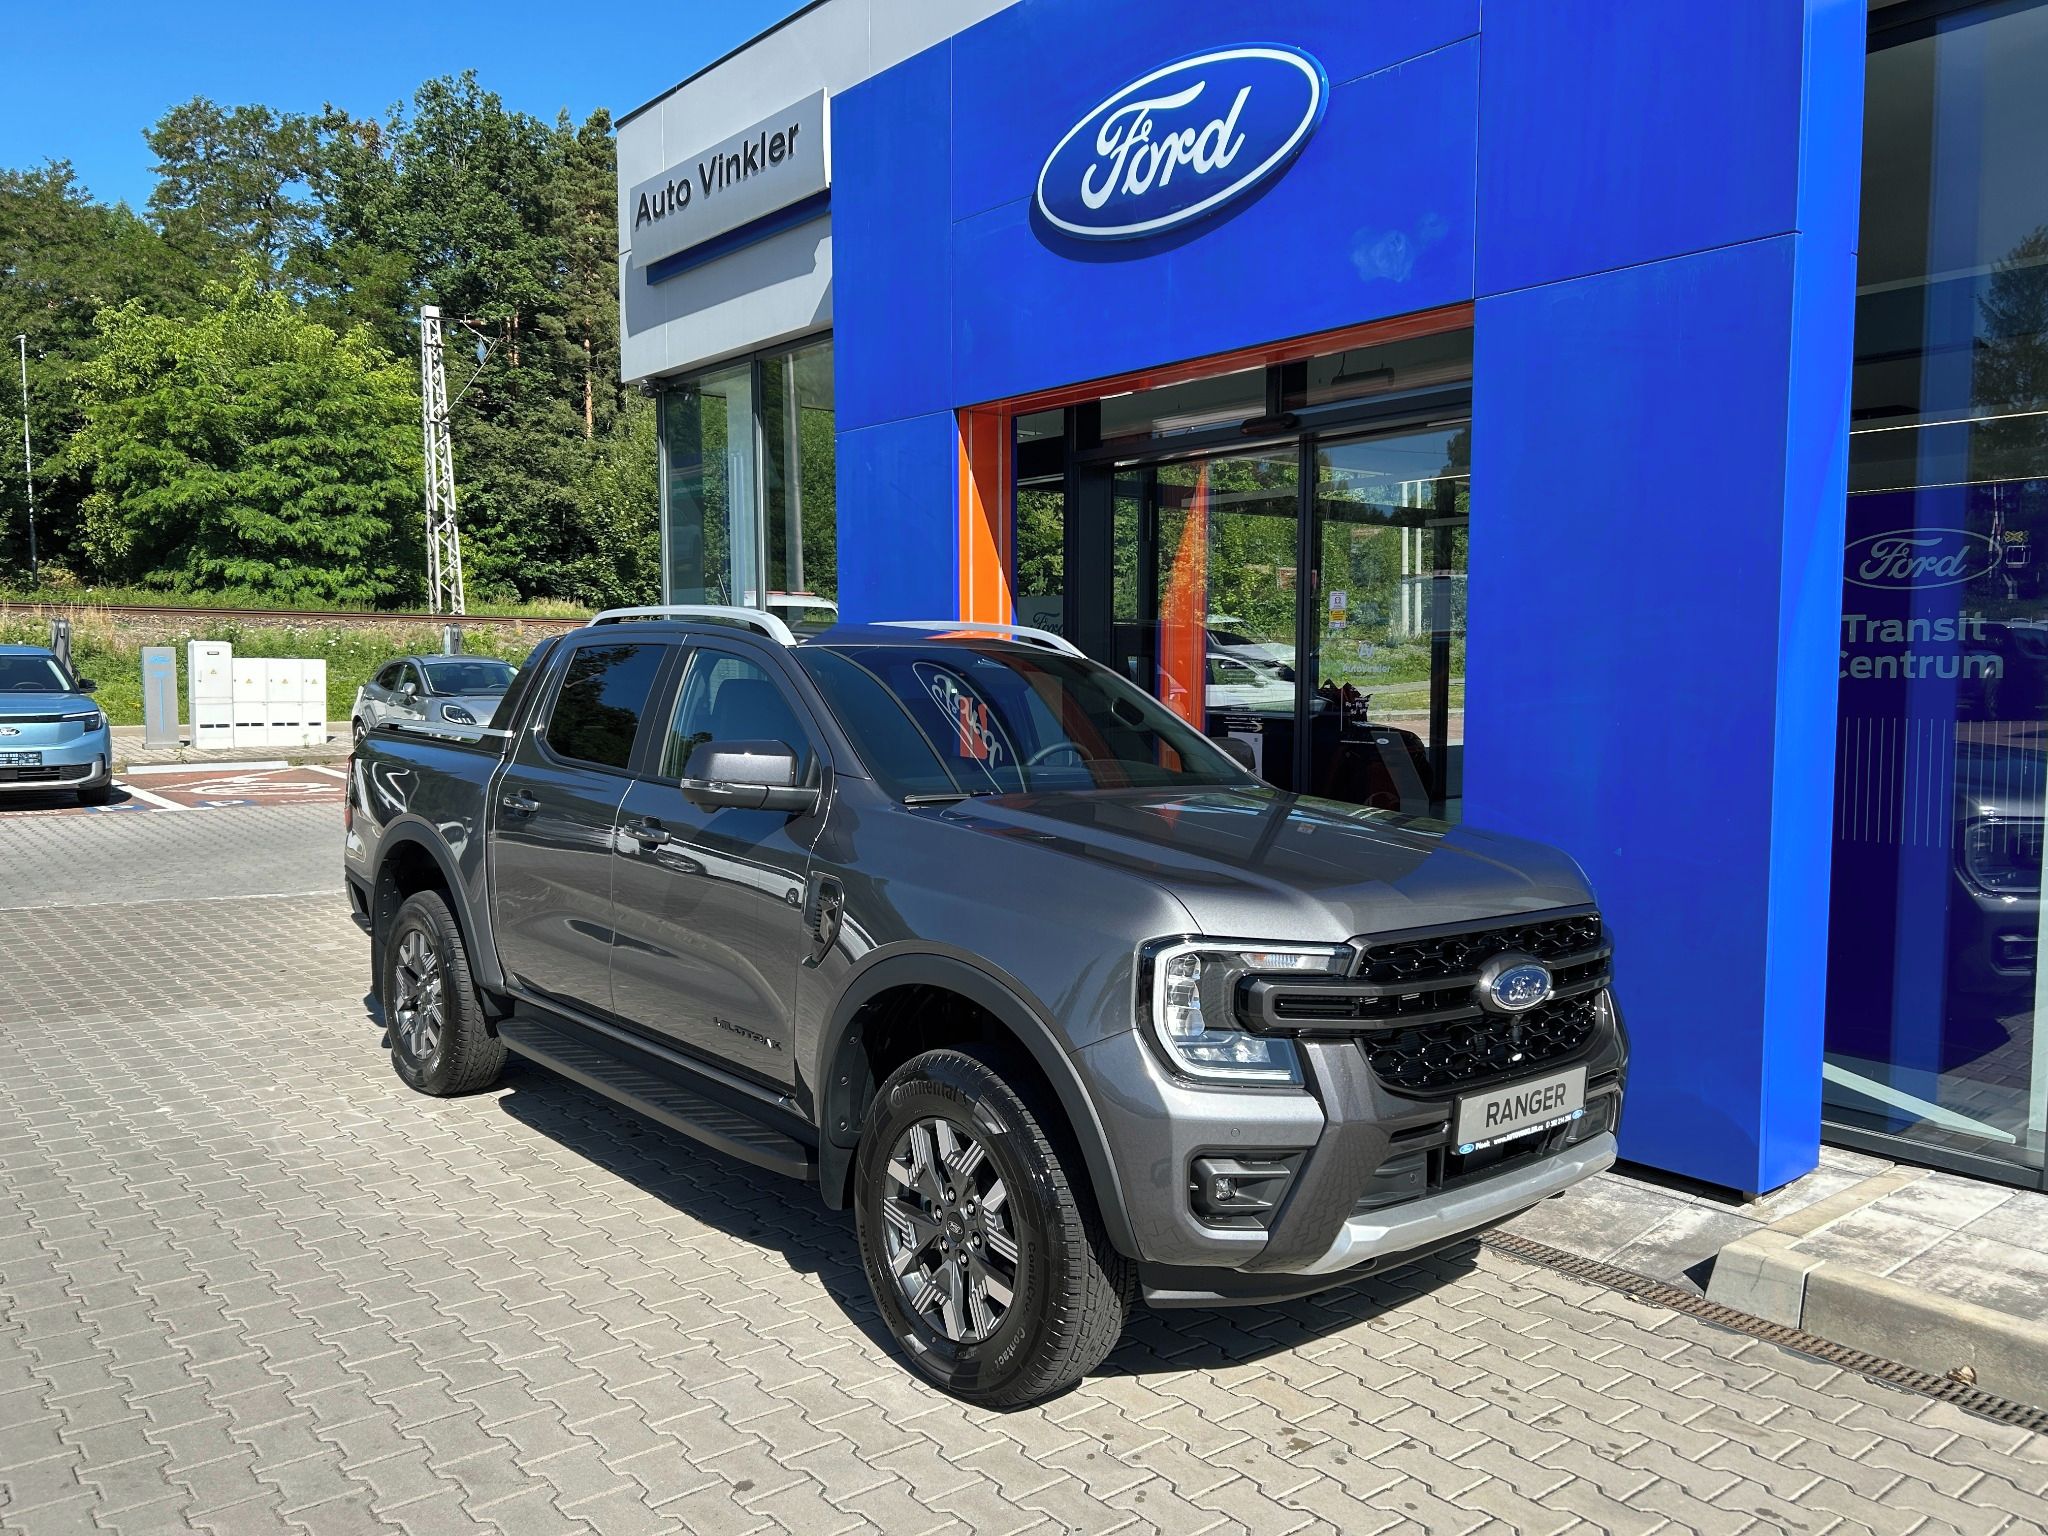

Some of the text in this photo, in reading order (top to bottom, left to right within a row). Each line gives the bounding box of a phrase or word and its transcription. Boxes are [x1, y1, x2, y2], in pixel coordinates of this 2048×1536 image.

[1081, 80, 1252, 210] Ford
[634, 120, 800, 231] Auto Vinkler
[1859, 537, 1971, 581] Ford
[1842, 611, 1987, 643] Transit
[1485, 1083, 1567, 1127] RANGER
